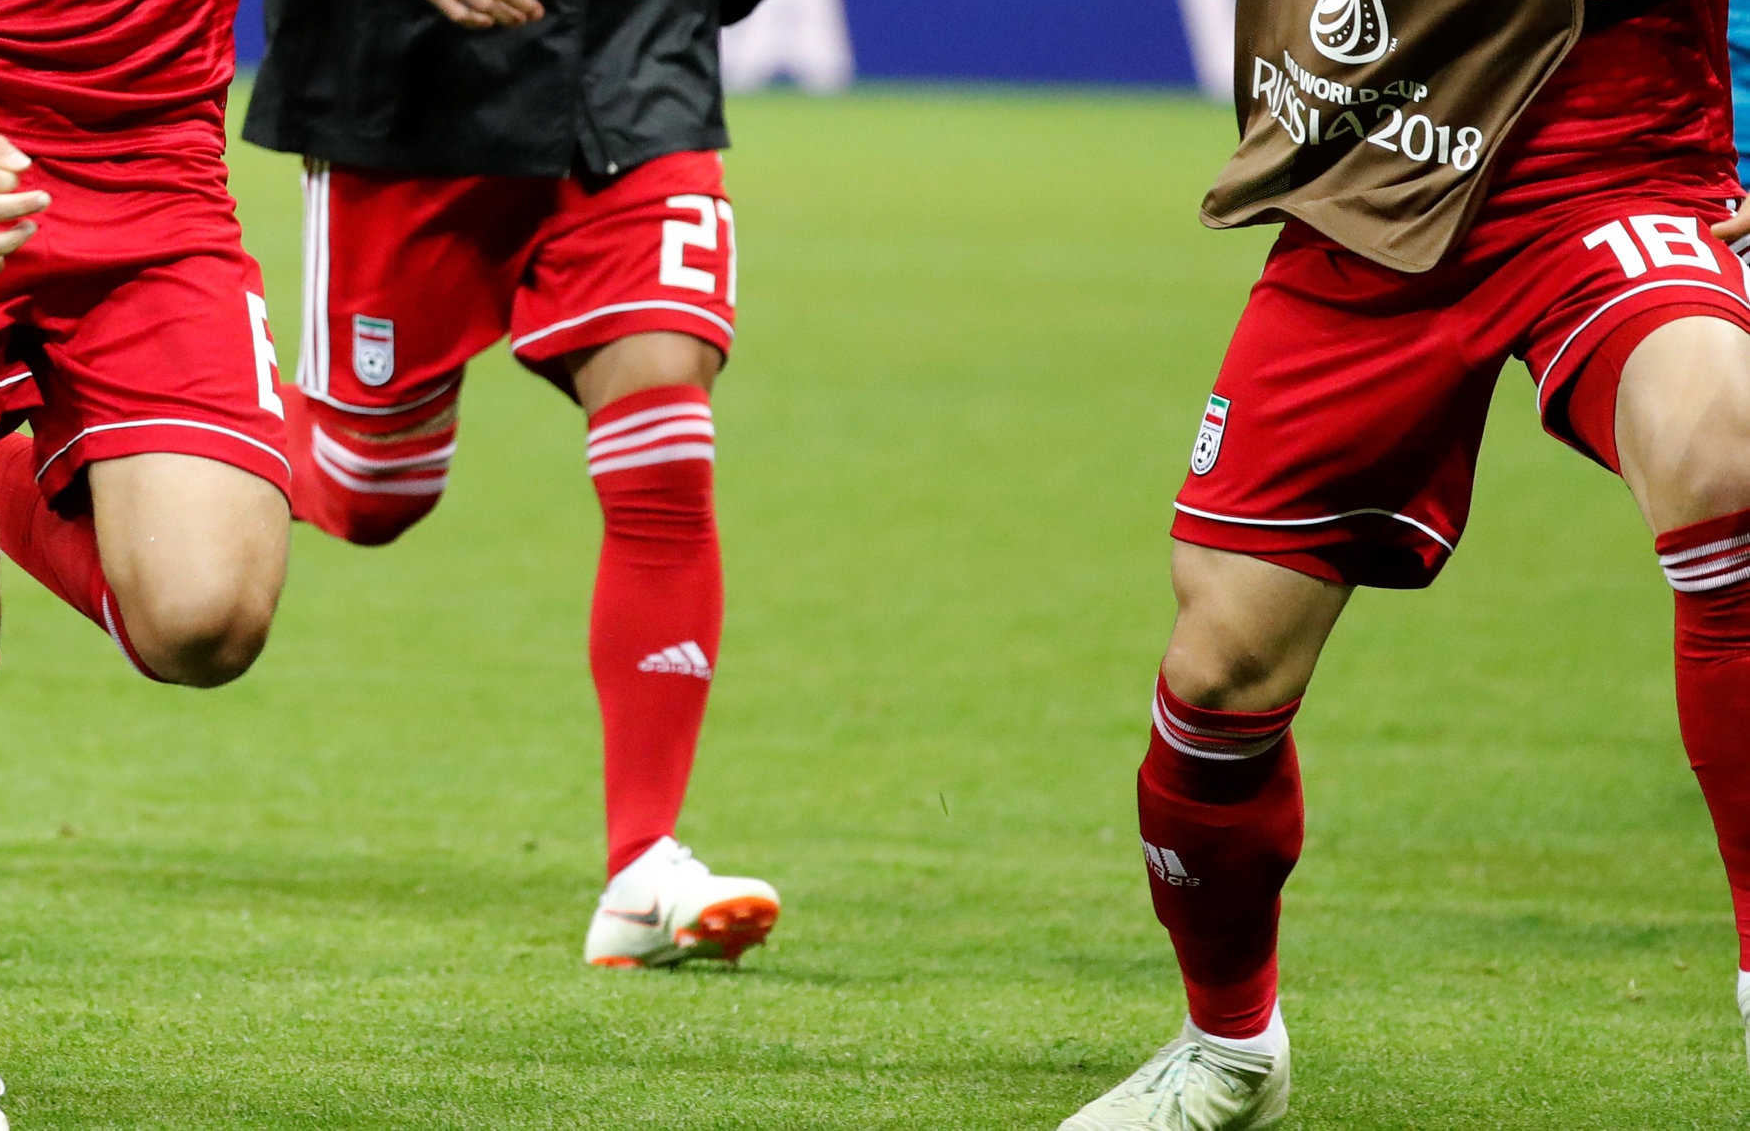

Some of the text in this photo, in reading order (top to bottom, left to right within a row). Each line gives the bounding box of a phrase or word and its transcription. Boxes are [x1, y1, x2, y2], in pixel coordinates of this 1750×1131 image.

[1252, 56, 1483, 172] RUSSIA 2018
[1299, 68, 1379, 105] WORLD
[1382, 80, 1428, 103] CUP
[1581, 214, 1722, 279] 18
